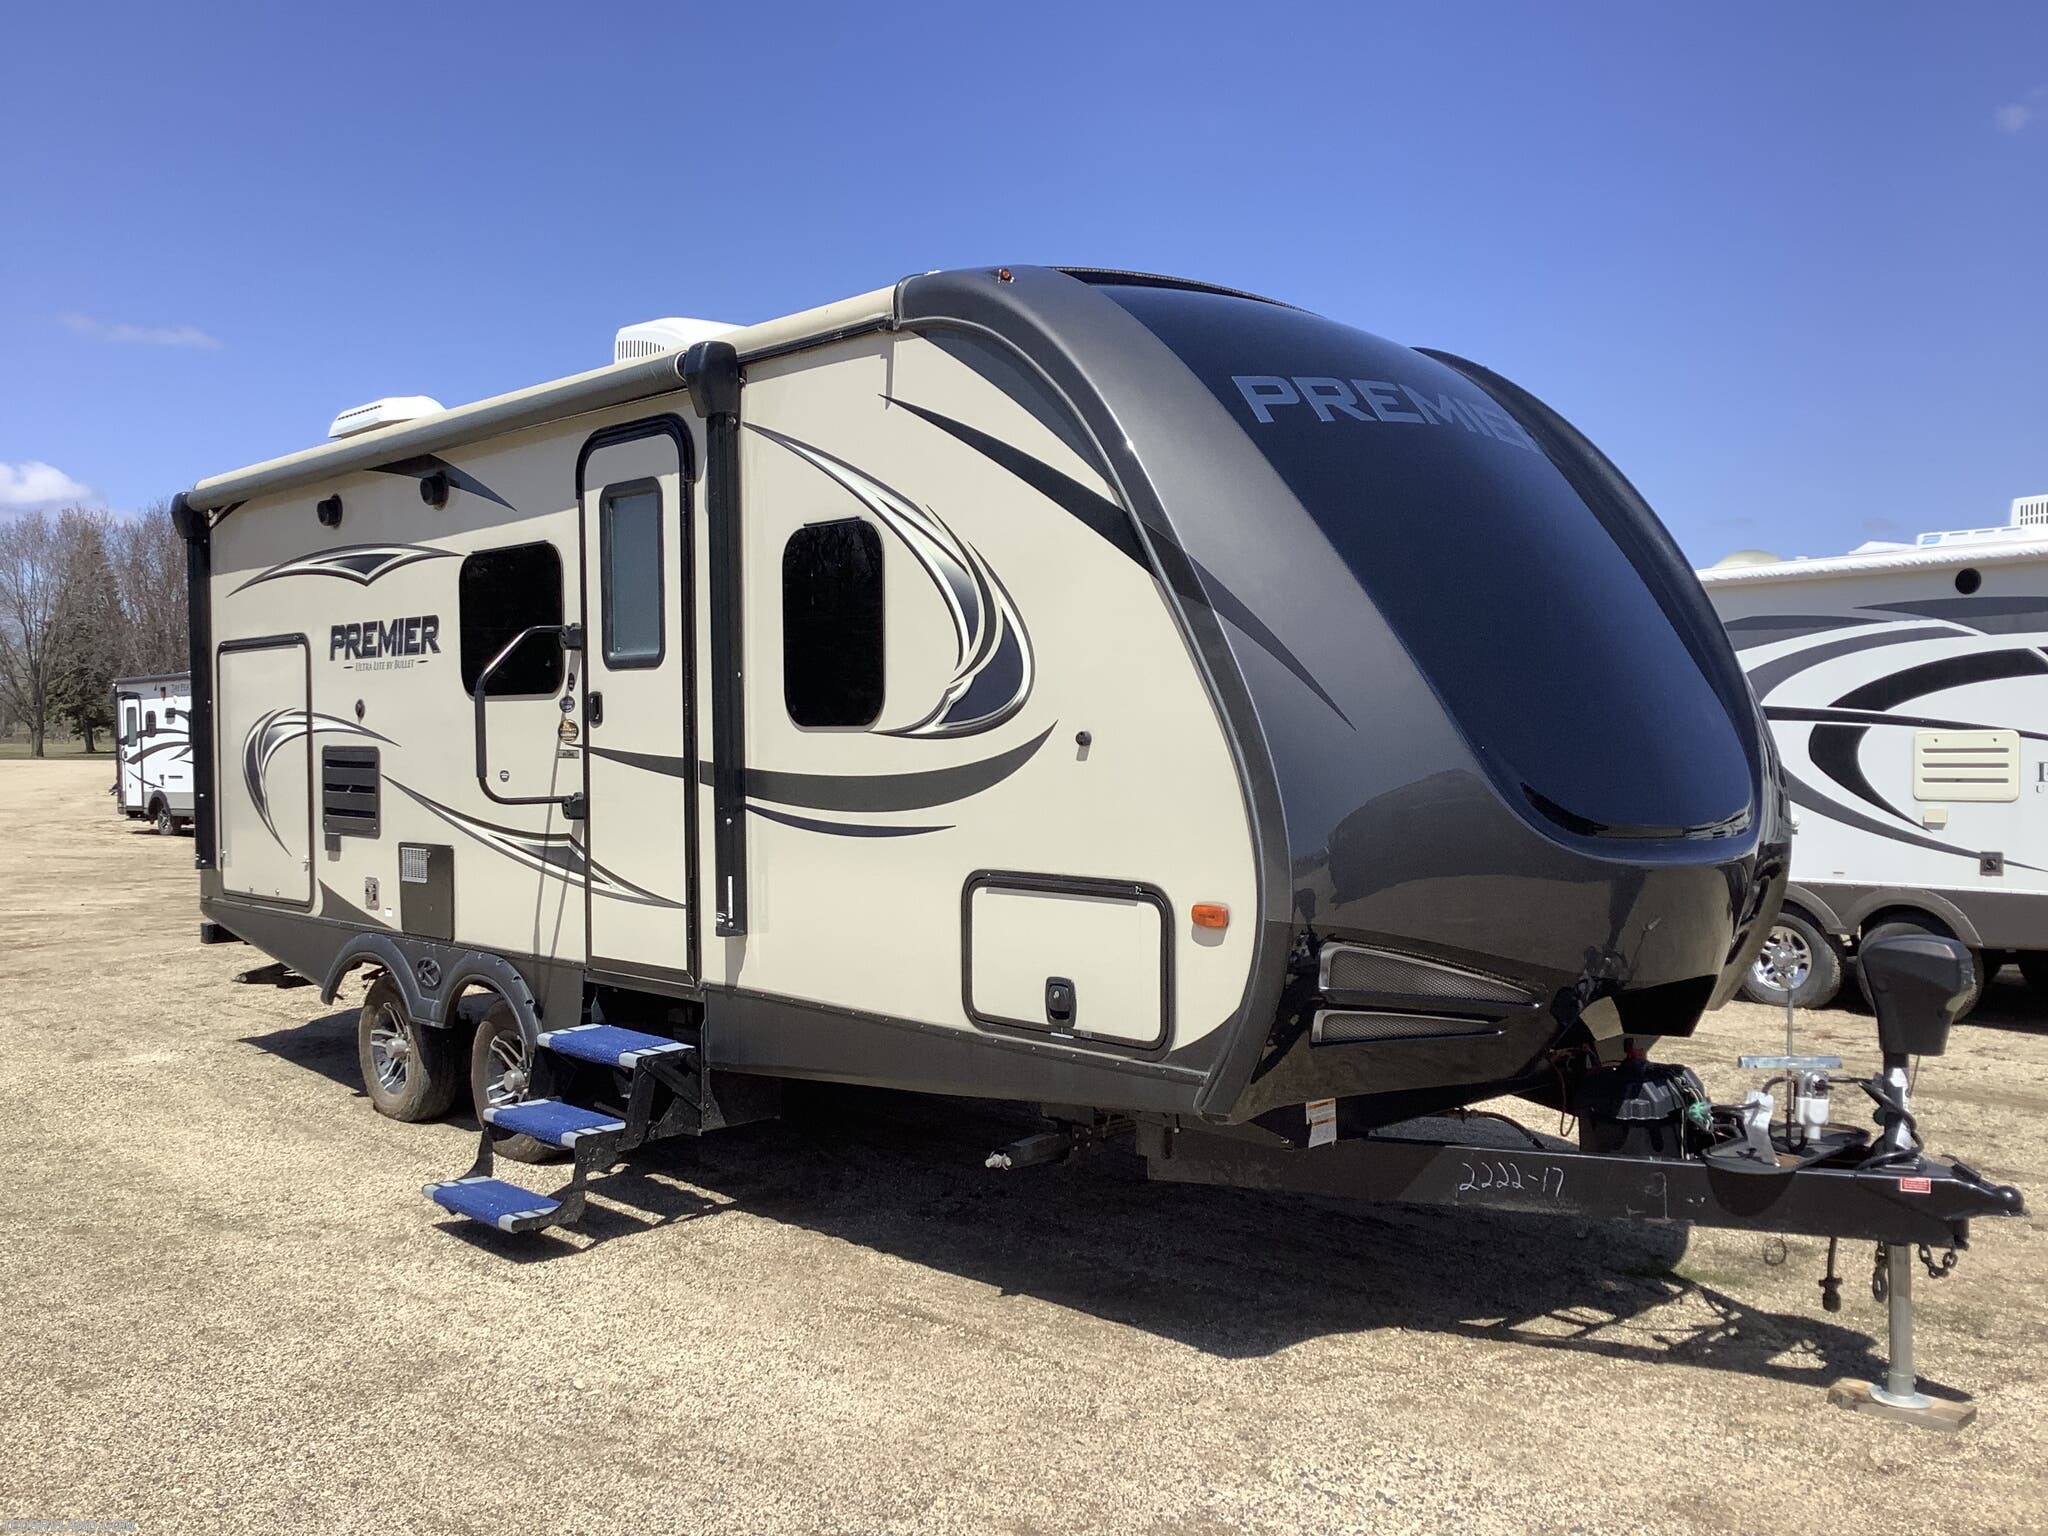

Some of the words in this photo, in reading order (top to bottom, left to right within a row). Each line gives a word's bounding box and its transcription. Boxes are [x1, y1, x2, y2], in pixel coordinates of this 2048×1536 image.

[1231, 375, 1542, 455] PREMIE
[329, 614, 441, 661] PREMIER
[1458, 1161, 1565, 1199] 2222-17
